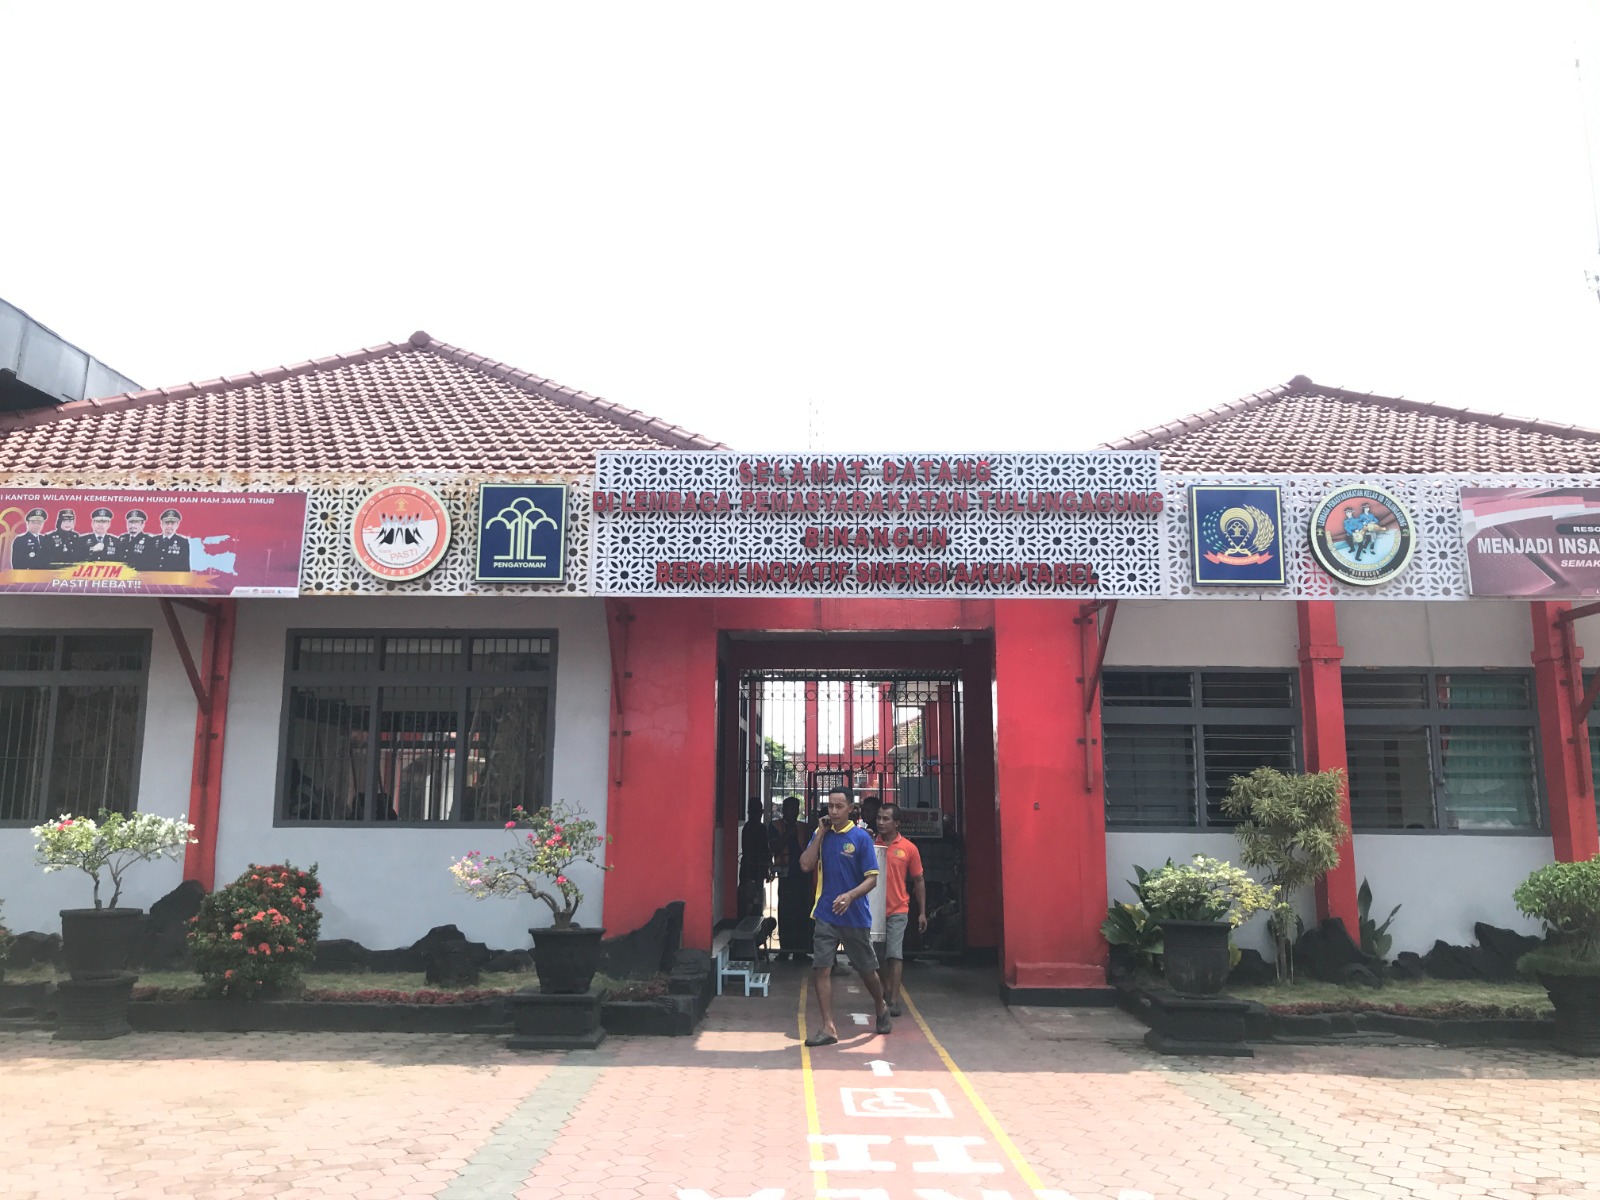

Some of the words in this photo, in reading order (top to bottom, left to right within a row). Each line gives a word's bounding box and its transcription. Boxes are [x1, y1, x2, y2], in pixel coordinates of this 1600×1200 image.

[738, 461, 866, 484] SELAMAT
[882, 460, 992, 483] DATANG
[5, 493, 41, 501] KANTOR
[42, 493, 82, 502] WILAYAH
[84, 494, 145, 503] KEMENTERIAN
[180, 496, 199, 504] DAN
[200, 496, 220, 504] HAM
[248, 497, 275, 505] TIMUR
[362, 487, 441, 515] CORPORATE
[592, 491, 615, 512] DI
[621, 491, 731, 512] LEMBAGA
[741, 491, 969, 513] PEMASYARAKATAN
[977, 491, 1164, 513] TULUNGAGUNG
[803, 526, 948, 549] BINANGUN
[1477, 537, 1554, 554] MENJADI
[1558, 537, 1600, 554] INSA
[363, 555, 433, 576] UNIVERSITY
[390, 549, 418, 561] PASTI
[72, 565, 123, 578] JATIM
[655, 561, 741, 584] BERSIH
[746, 561, 850, 584] INOVATIF
[855, 561, 948, 584] SINERGI
[953, 562, 1099, 585] AKUNTABEL
[51, 579, 88, 588] PASTI
[91, 579, 142, 589] HEBAT!!
